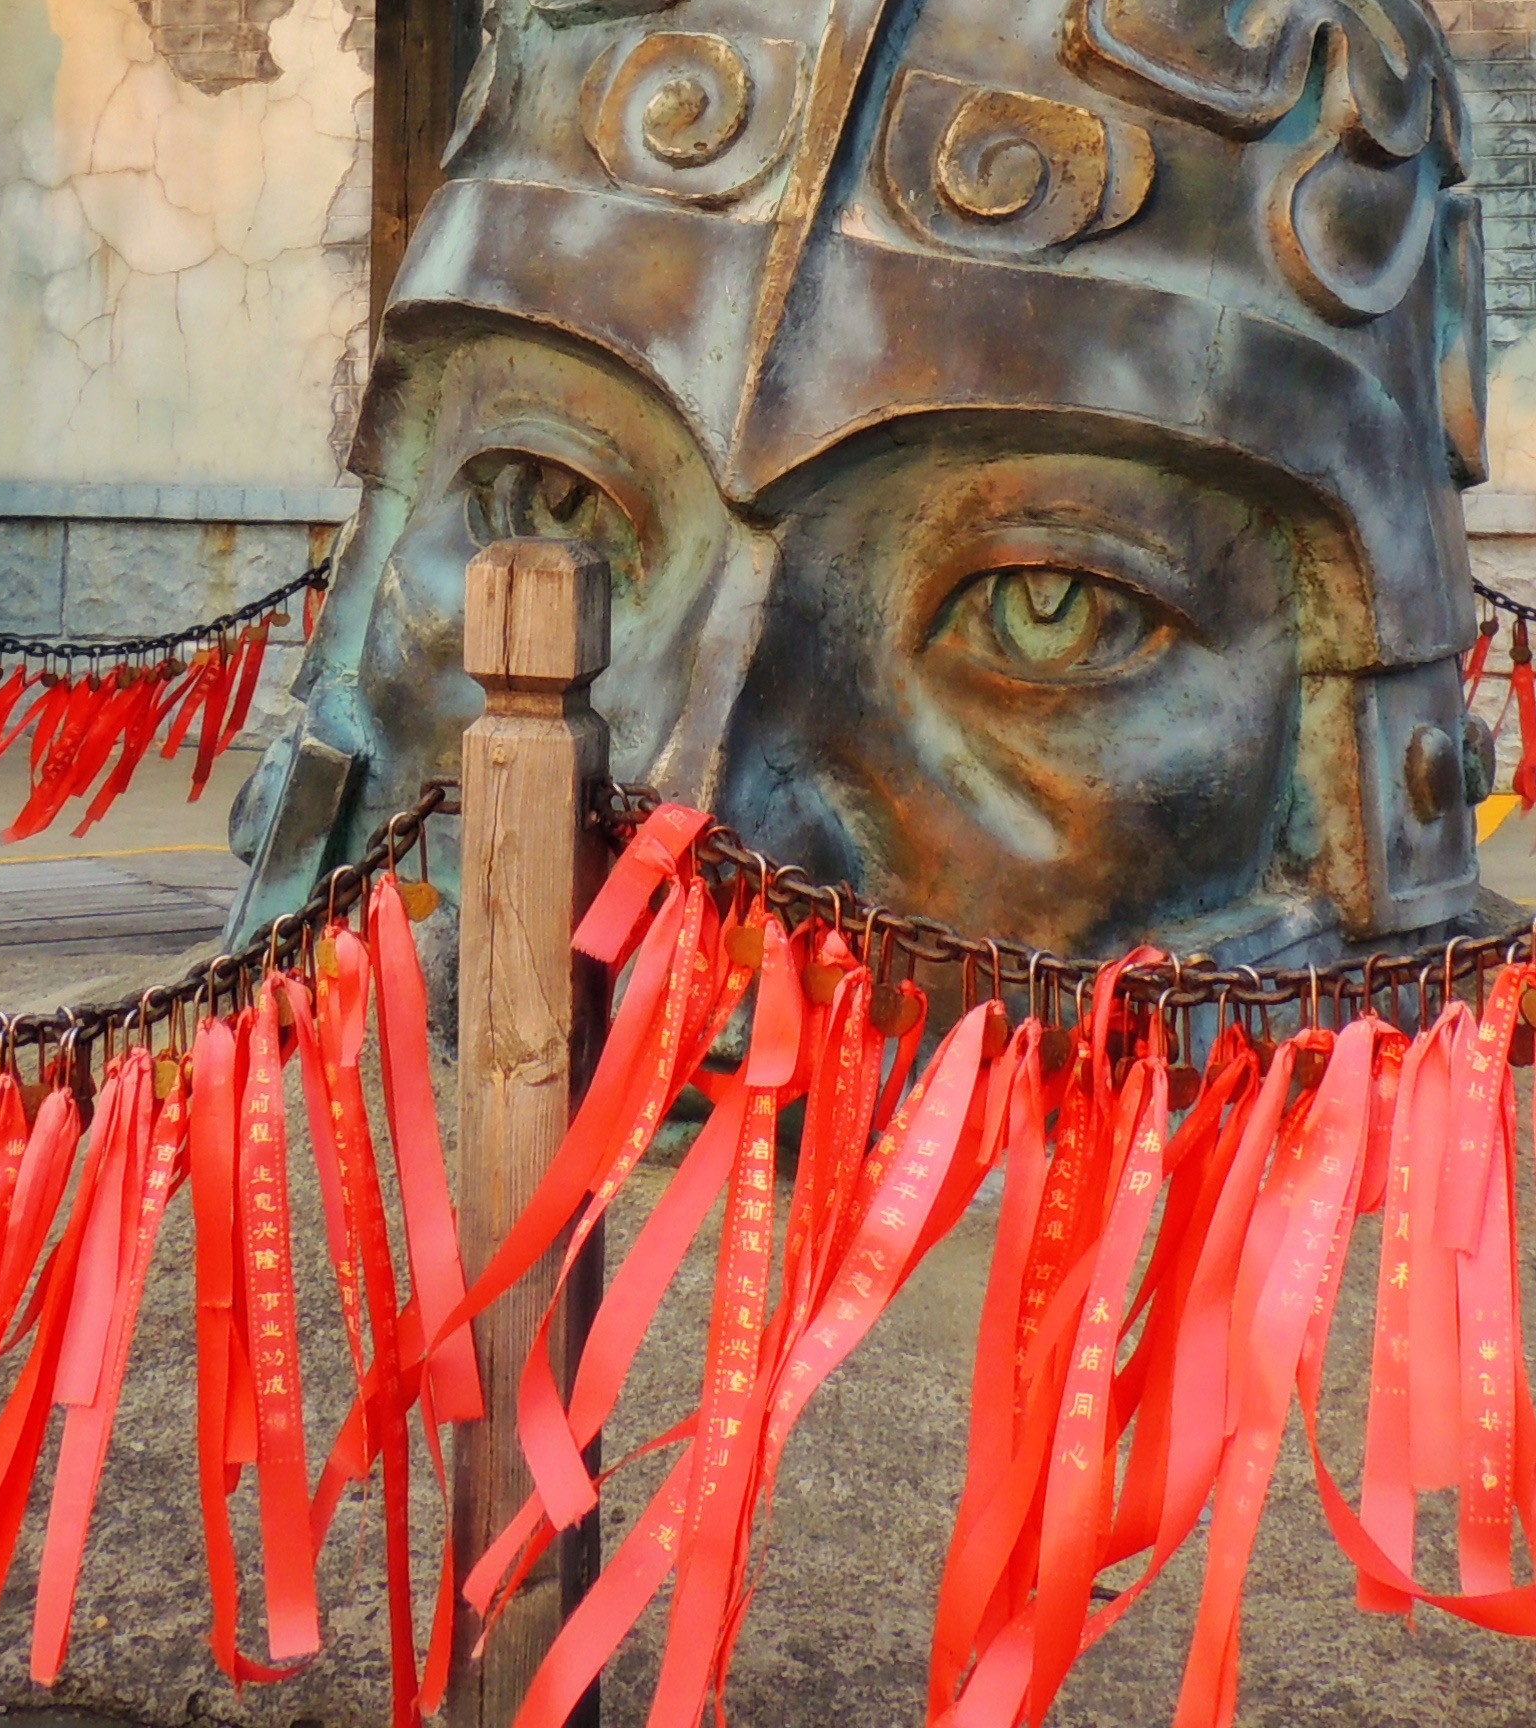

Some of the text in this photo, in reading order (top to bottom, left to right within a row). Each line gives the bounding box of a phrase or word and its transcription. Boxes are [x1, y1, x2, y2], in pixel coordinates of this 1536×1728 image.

[739, 1137, 771, 1254] 启运前程
[879, 1137, 941, 1231] 吉祥平安
[1043, 1127, 1077, 1242] 消灾免难
[1060, 1296, 1111, 1472] 永结同心
